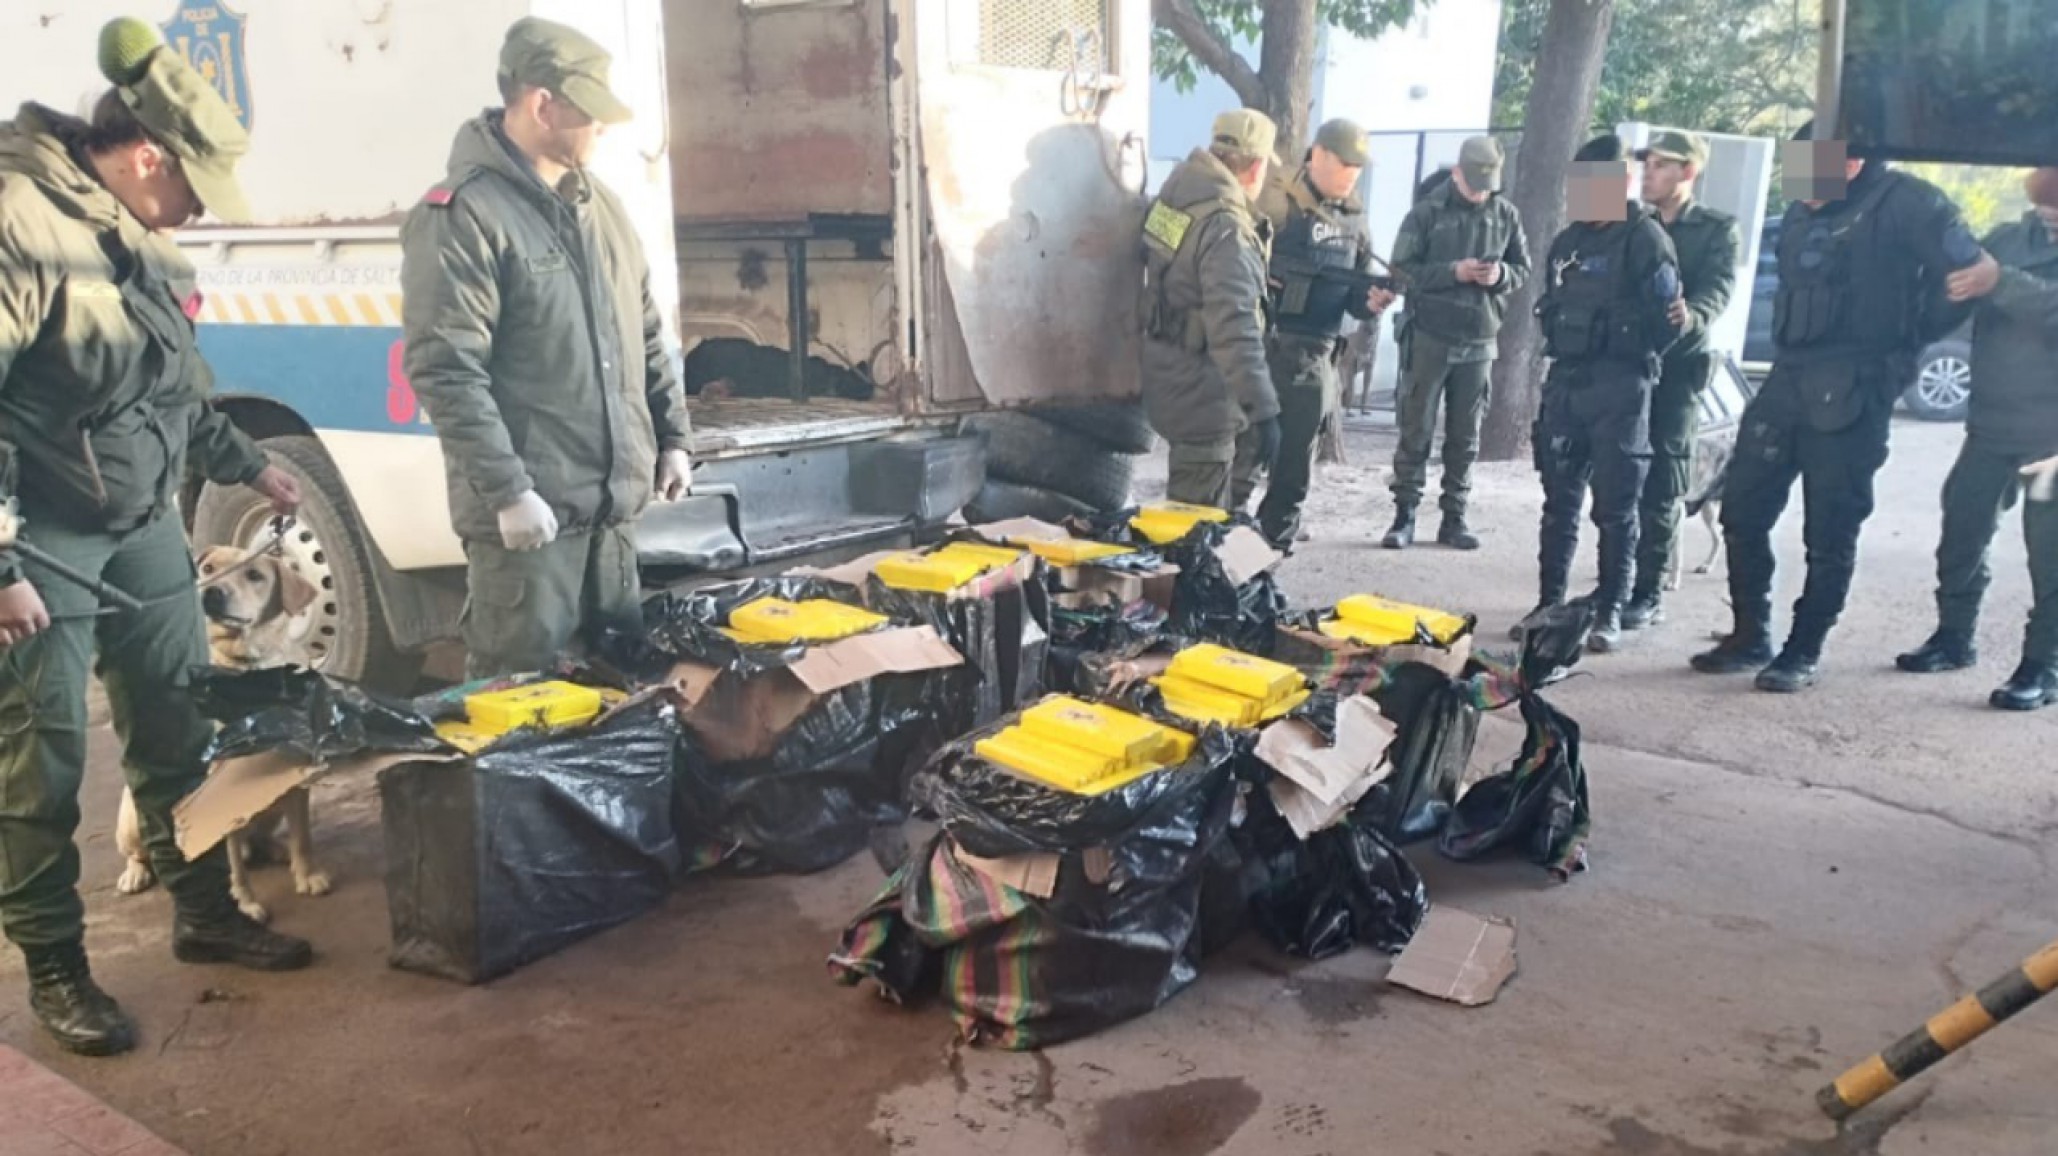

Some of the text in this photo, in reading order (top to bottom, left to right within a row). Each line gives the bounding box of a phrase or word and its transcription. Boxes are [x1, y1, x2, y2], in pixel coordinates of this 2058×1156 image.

[267, 268, 336, 285] PROVINCIA
[340, 267, 360, 284] DE
[363, 266, 400, 285] SALT
